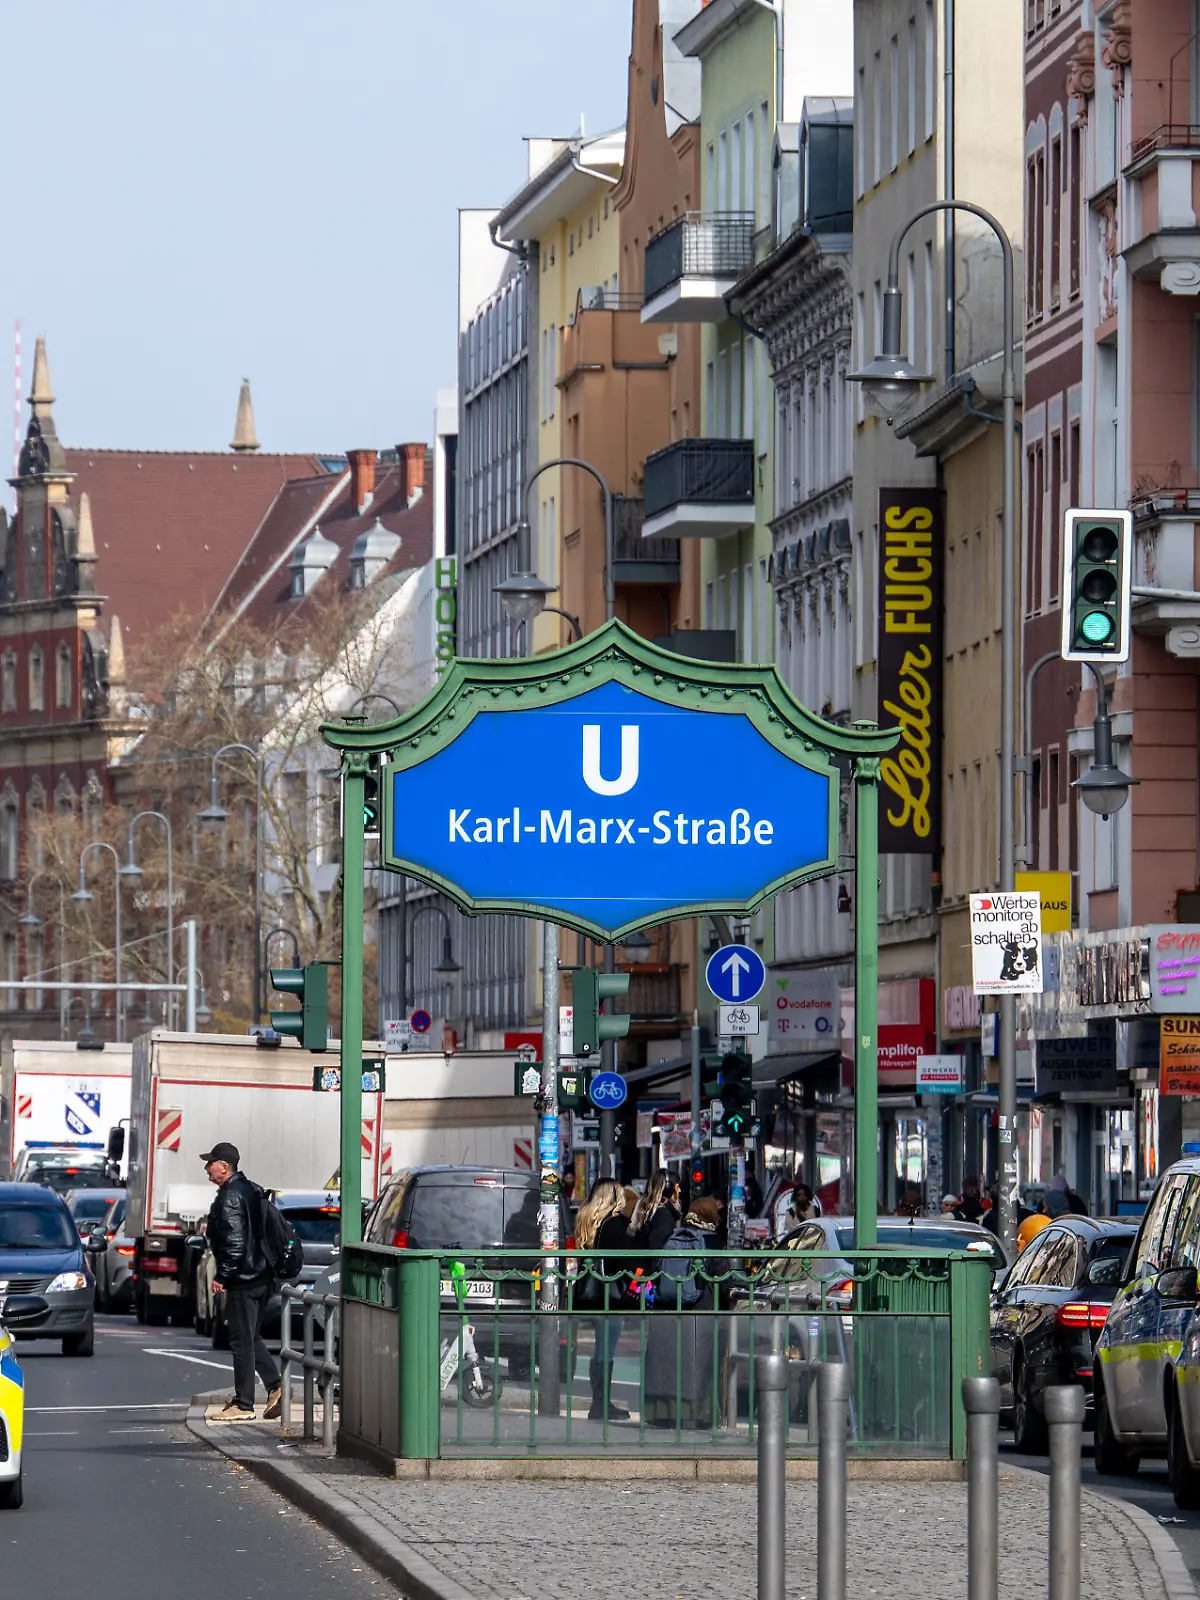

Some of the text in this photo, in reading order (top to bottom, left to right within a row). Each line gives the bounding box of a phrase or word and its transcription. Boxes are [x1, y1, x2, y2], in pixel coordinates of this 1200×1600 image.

[880, 505, 933, 838] Leder FUCHS
[582, 724, 639, 796] U
[448, 806, 775, 845] Karl-Marx-Straße
[991, 895, 1037, 909] Werbe
[972, 909, 1033, 922] monitore
[1020, 921, 1038, 933] ab
[974, 931, 1031, 945] schalten
[789, 1000, 832, 1009] vodafone
[877, 1044, 924, 1059] mplifon
[466, 1283, 492, 1293] 7103
